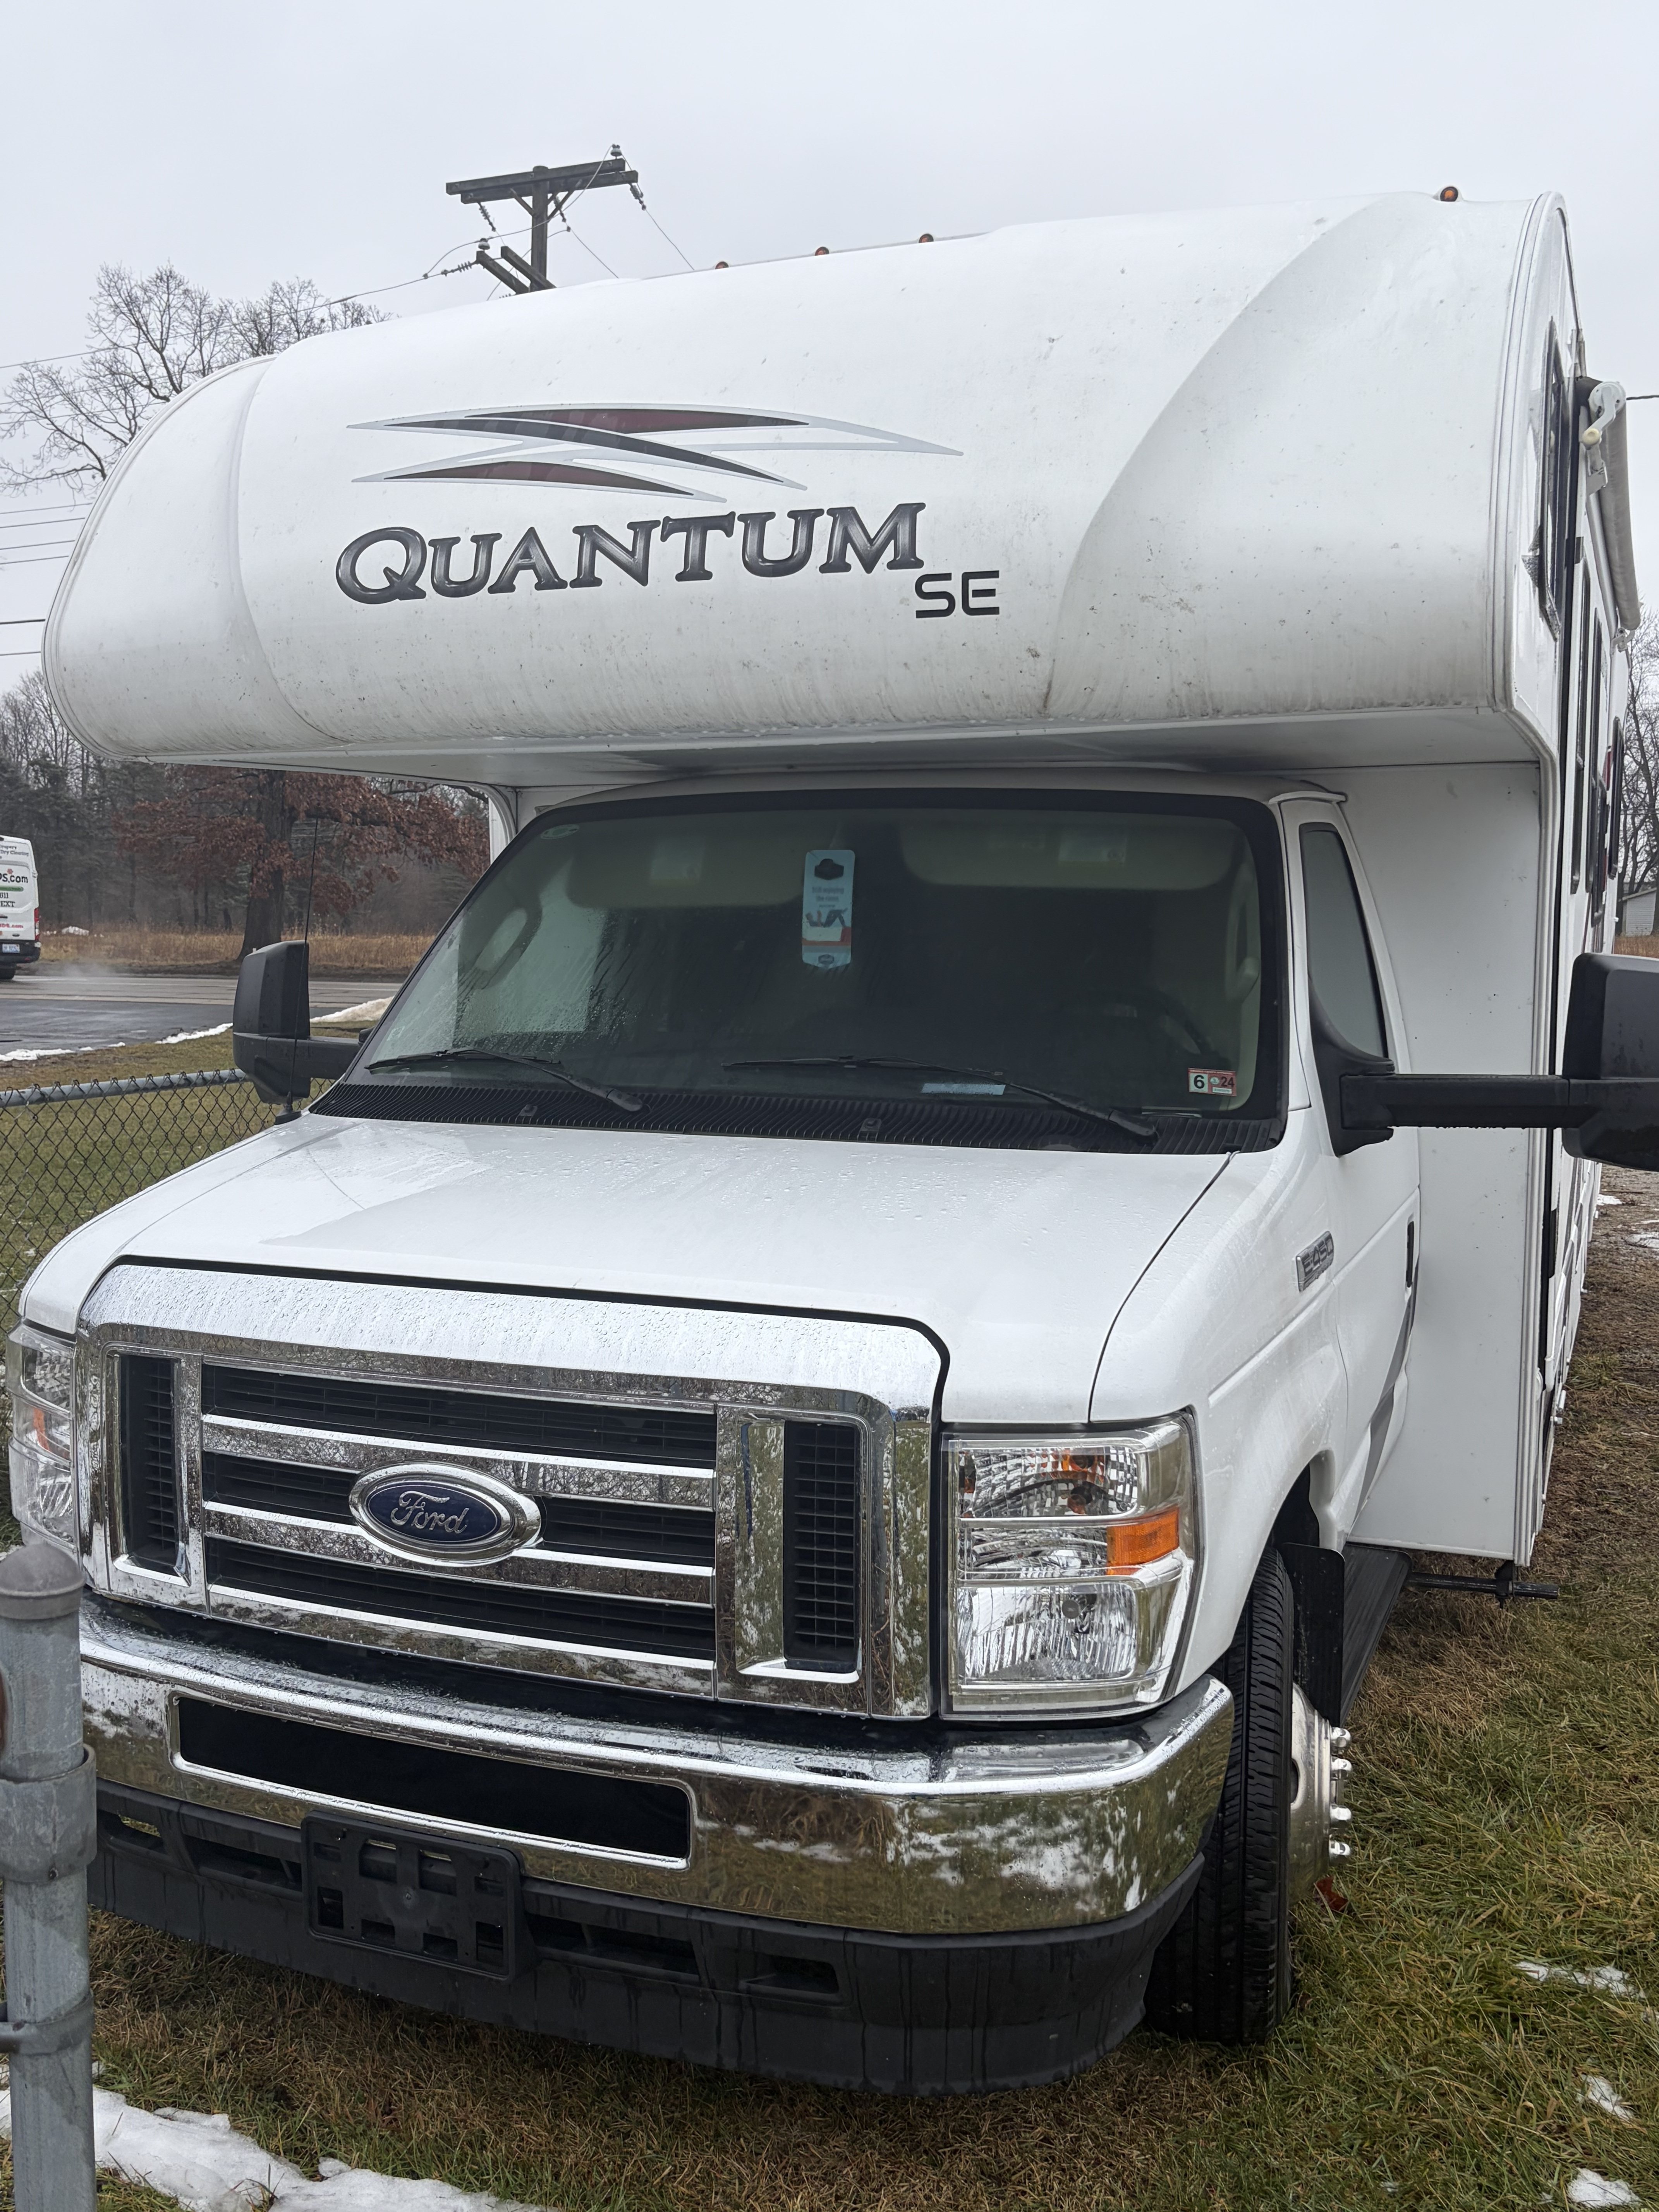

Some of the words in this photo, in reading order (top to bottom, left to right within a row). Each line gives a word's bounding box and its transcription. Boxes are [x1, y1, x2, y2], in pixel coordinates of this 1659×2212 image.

[336, 502, 926, 604] QUANTUM
[915, 570, 1000, 618] SE
[1194, 1075, 1205, 1089] 6
[1221, 1077, 1235, 1087] 24
[390, 1491, 469, 1534] Ford
